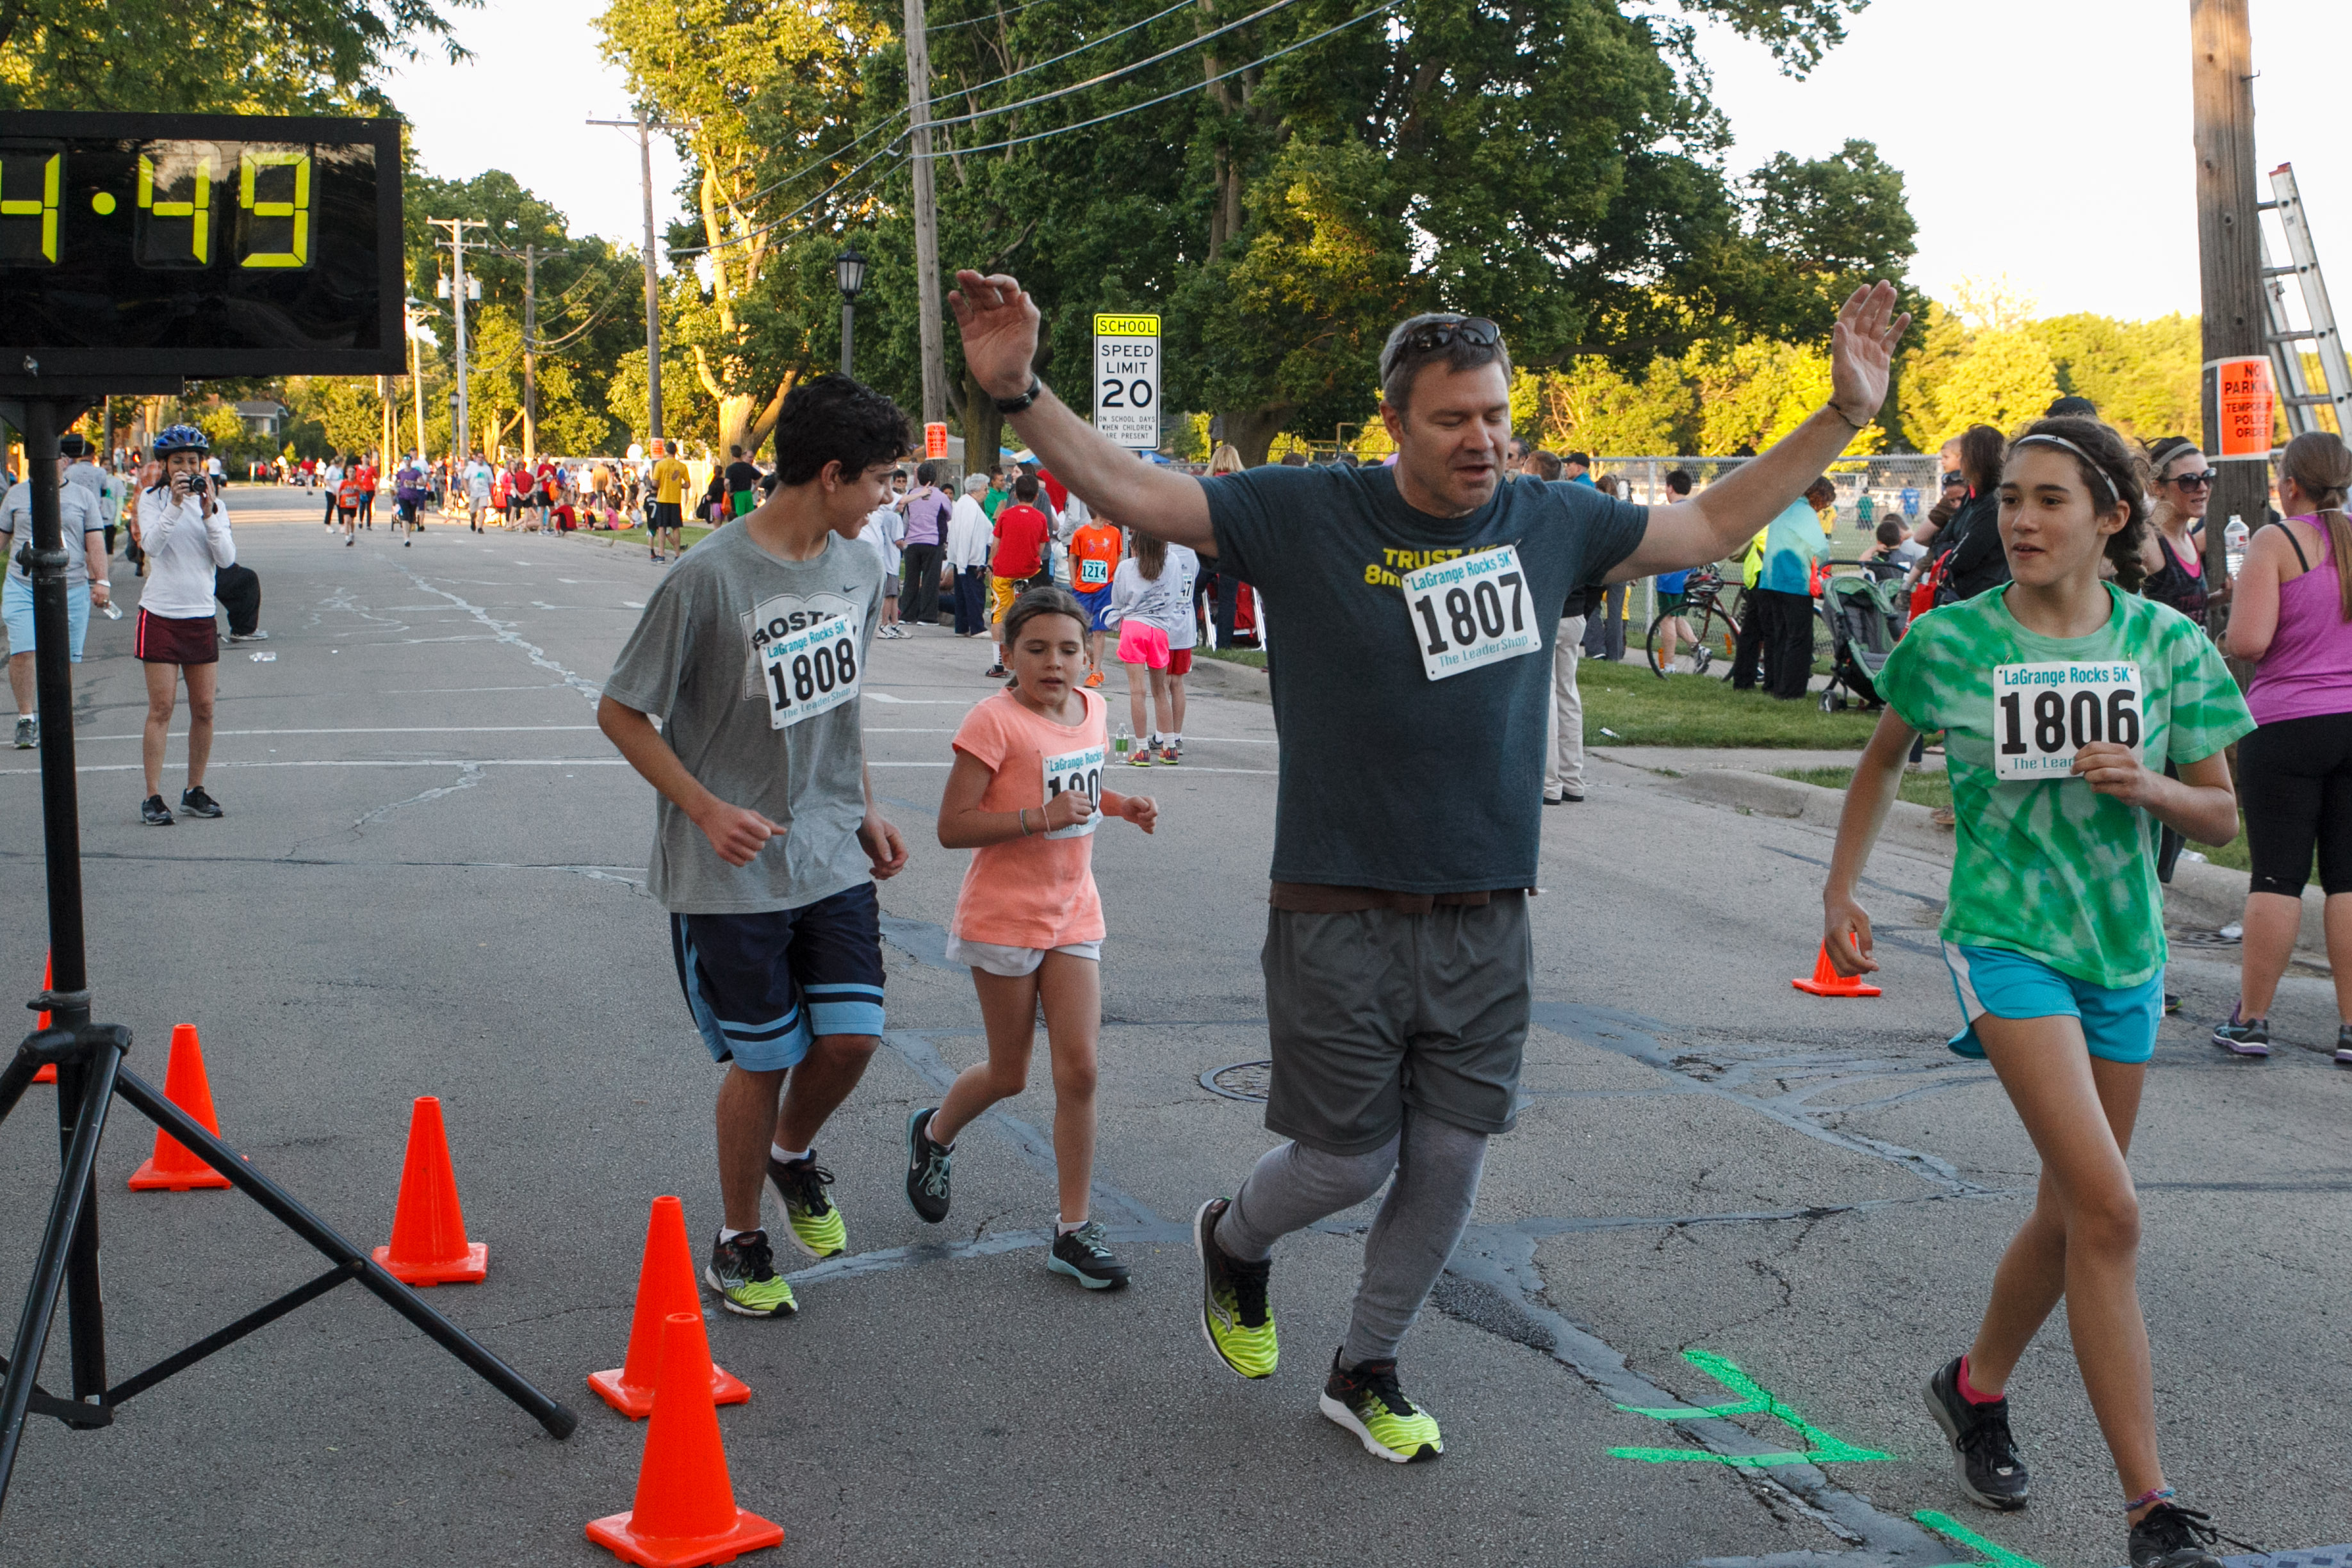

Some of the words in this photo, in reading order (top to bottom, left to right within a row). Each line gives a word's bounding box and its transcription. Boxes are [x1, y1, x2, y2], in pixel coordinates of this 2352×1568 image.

[1099, 320, 1155, 333] SCHOOL
[1101, 345, 1154, 357] SPEED
[1106, 362, 1147, 374] LIMIT
[1102, 379, 1152, 408] 20
[648, 502, 657, 519] 7
[1383, 548, 1462, 569] TRUST
[1082, 564, 1106, 578] 1214
[1410, 566, 1465, 591] LaGrange
[1466, 557, 1497, 577] Rocks
[1497, 551, 1512, 568] 5K
[1414, 571, 1524, 655] 1807
[767, 637, 808, 658] LaGrange
[809, 627, 834, 644] Rocks
[835, 619, 846, 634] 5K
[1439, 655, 1460, 667] The
[769, 637, 856, 712] 1808
[2004, 669, 2066, 687] LaGrange
[2070, 667, 2109, 683] Rocks
[2113, 666, 2130, 682] 5K
[782, 706, 799, 719] The
[2000, 689, 2139, 755] 1806
[1049, 756, 1084, 772] LaGrange
[2012, 757, 2038, 769] The
